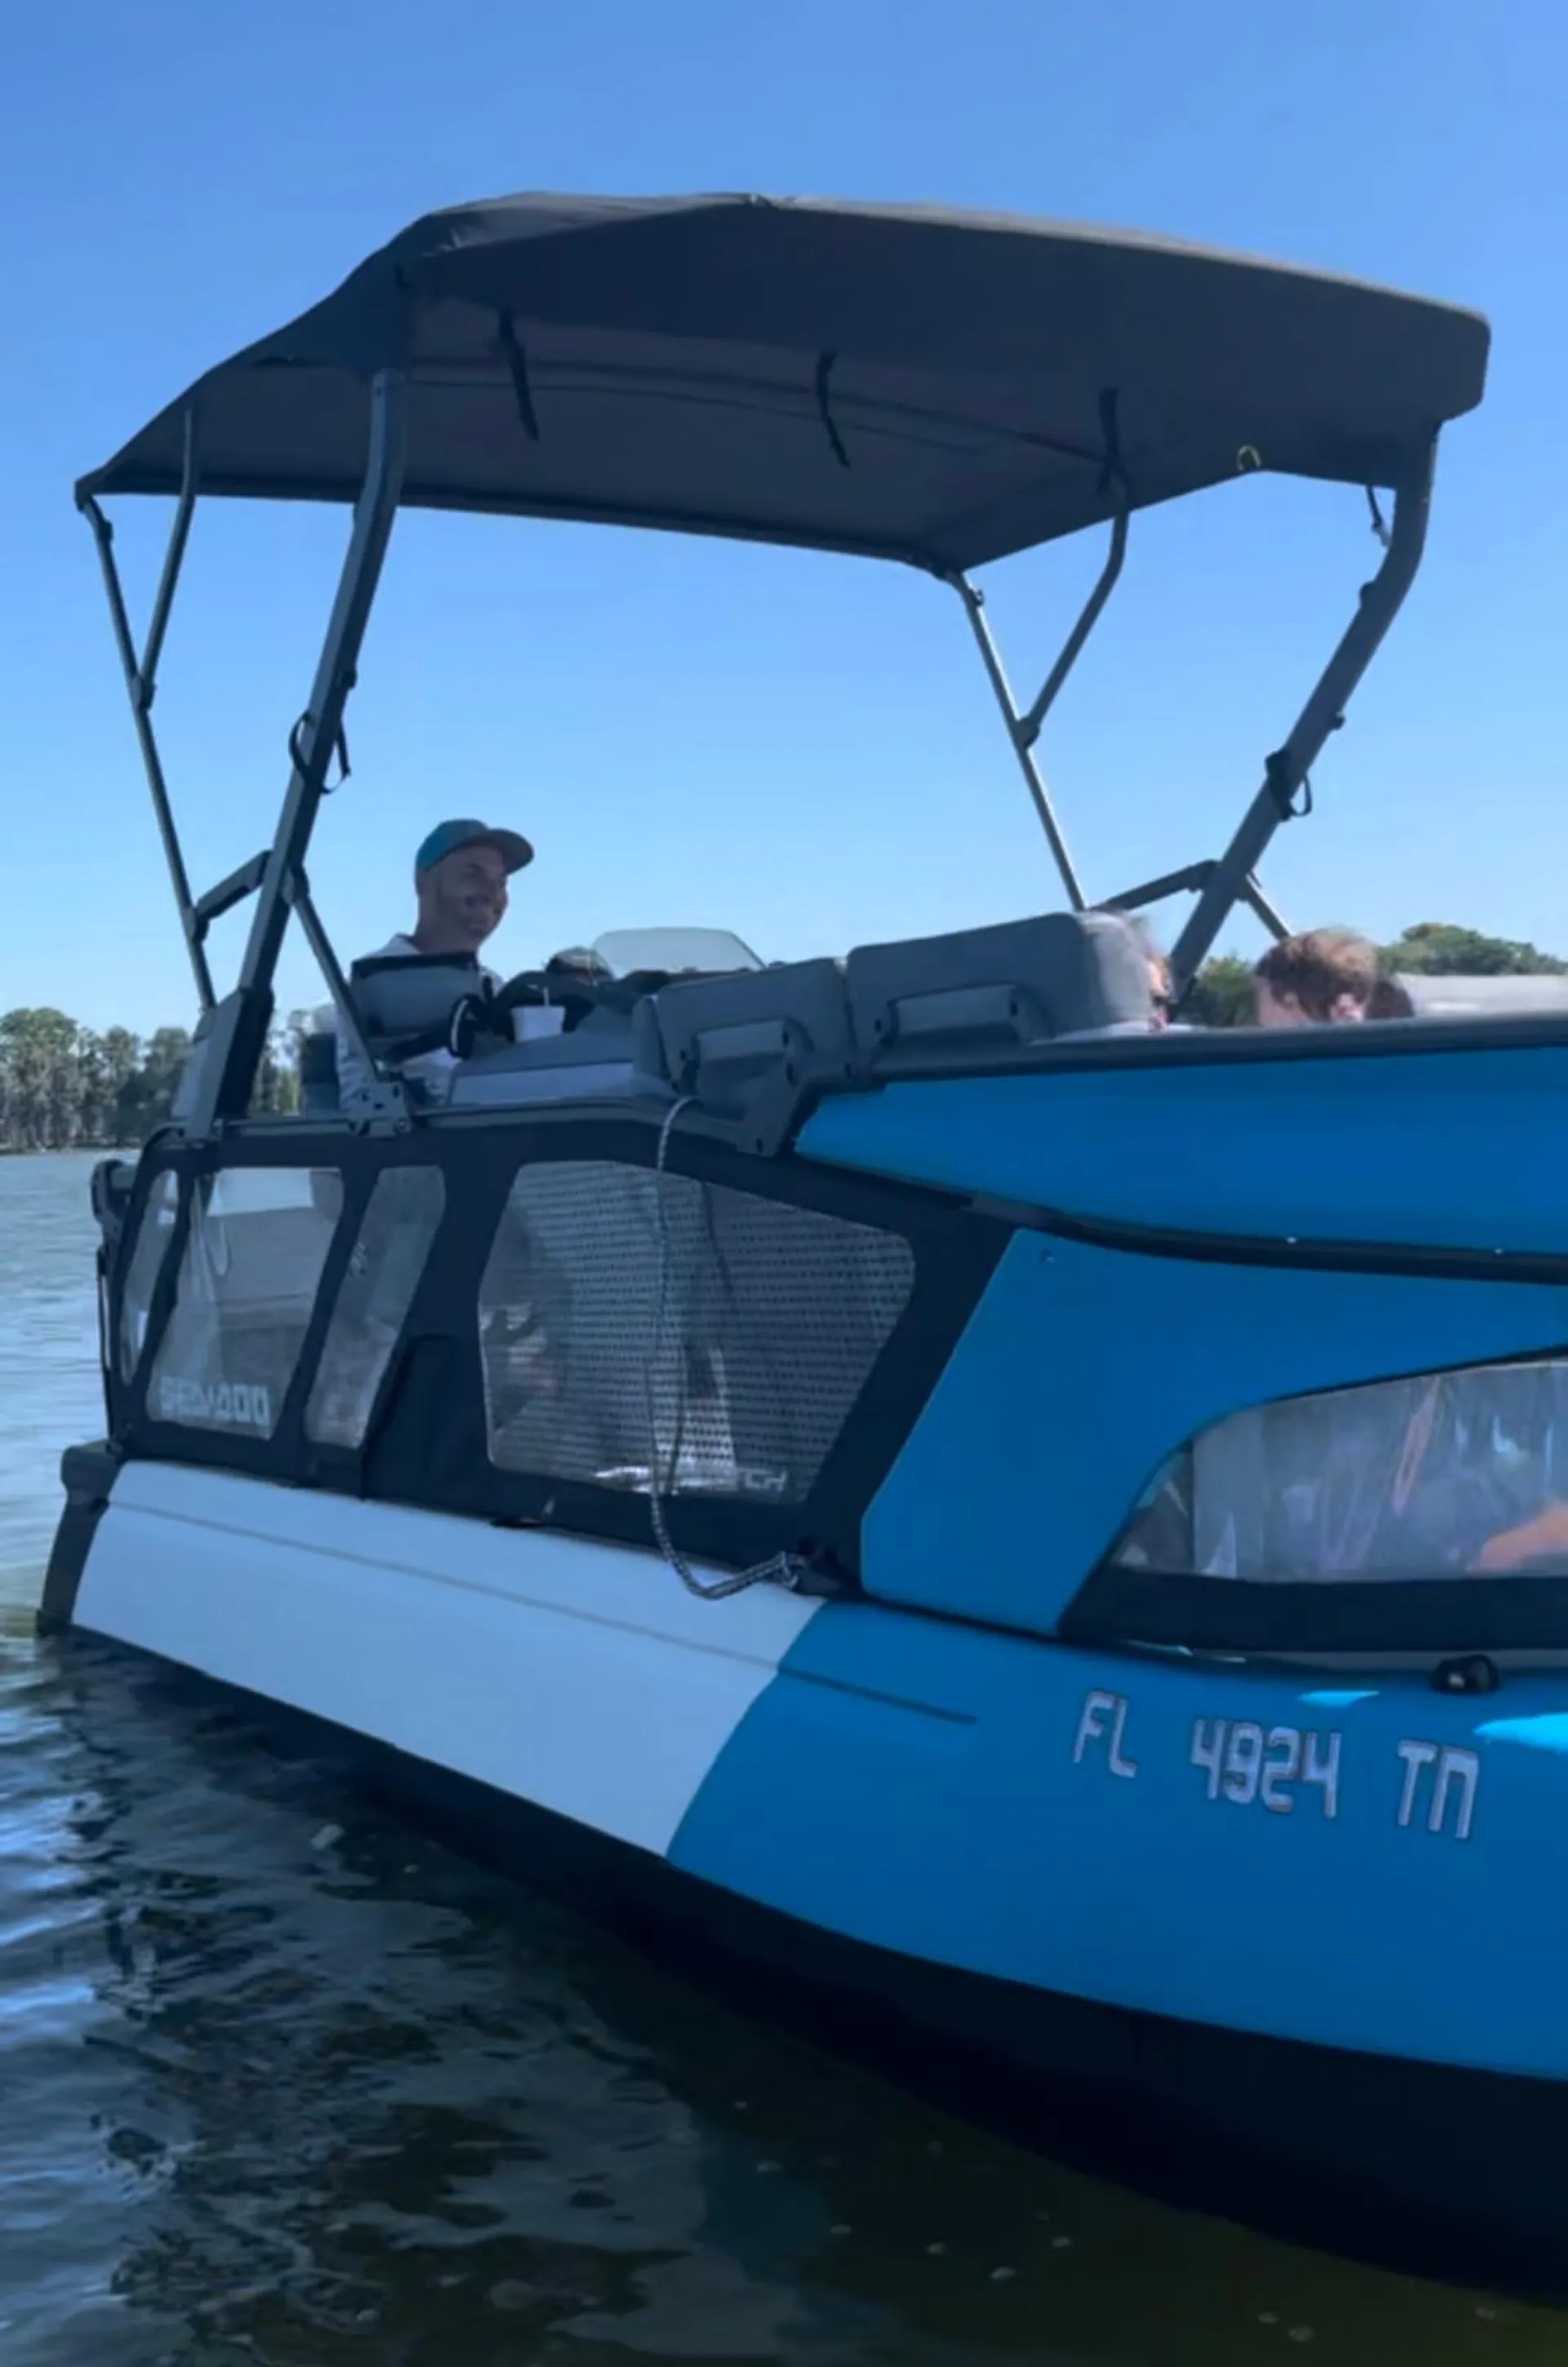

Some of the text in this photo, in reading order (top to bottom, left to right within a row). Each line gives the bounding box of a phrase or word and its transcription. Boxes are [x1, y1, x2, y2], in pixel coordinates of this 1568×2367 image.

[1072, 1690, 1480, 1839] FL 4924 TN
